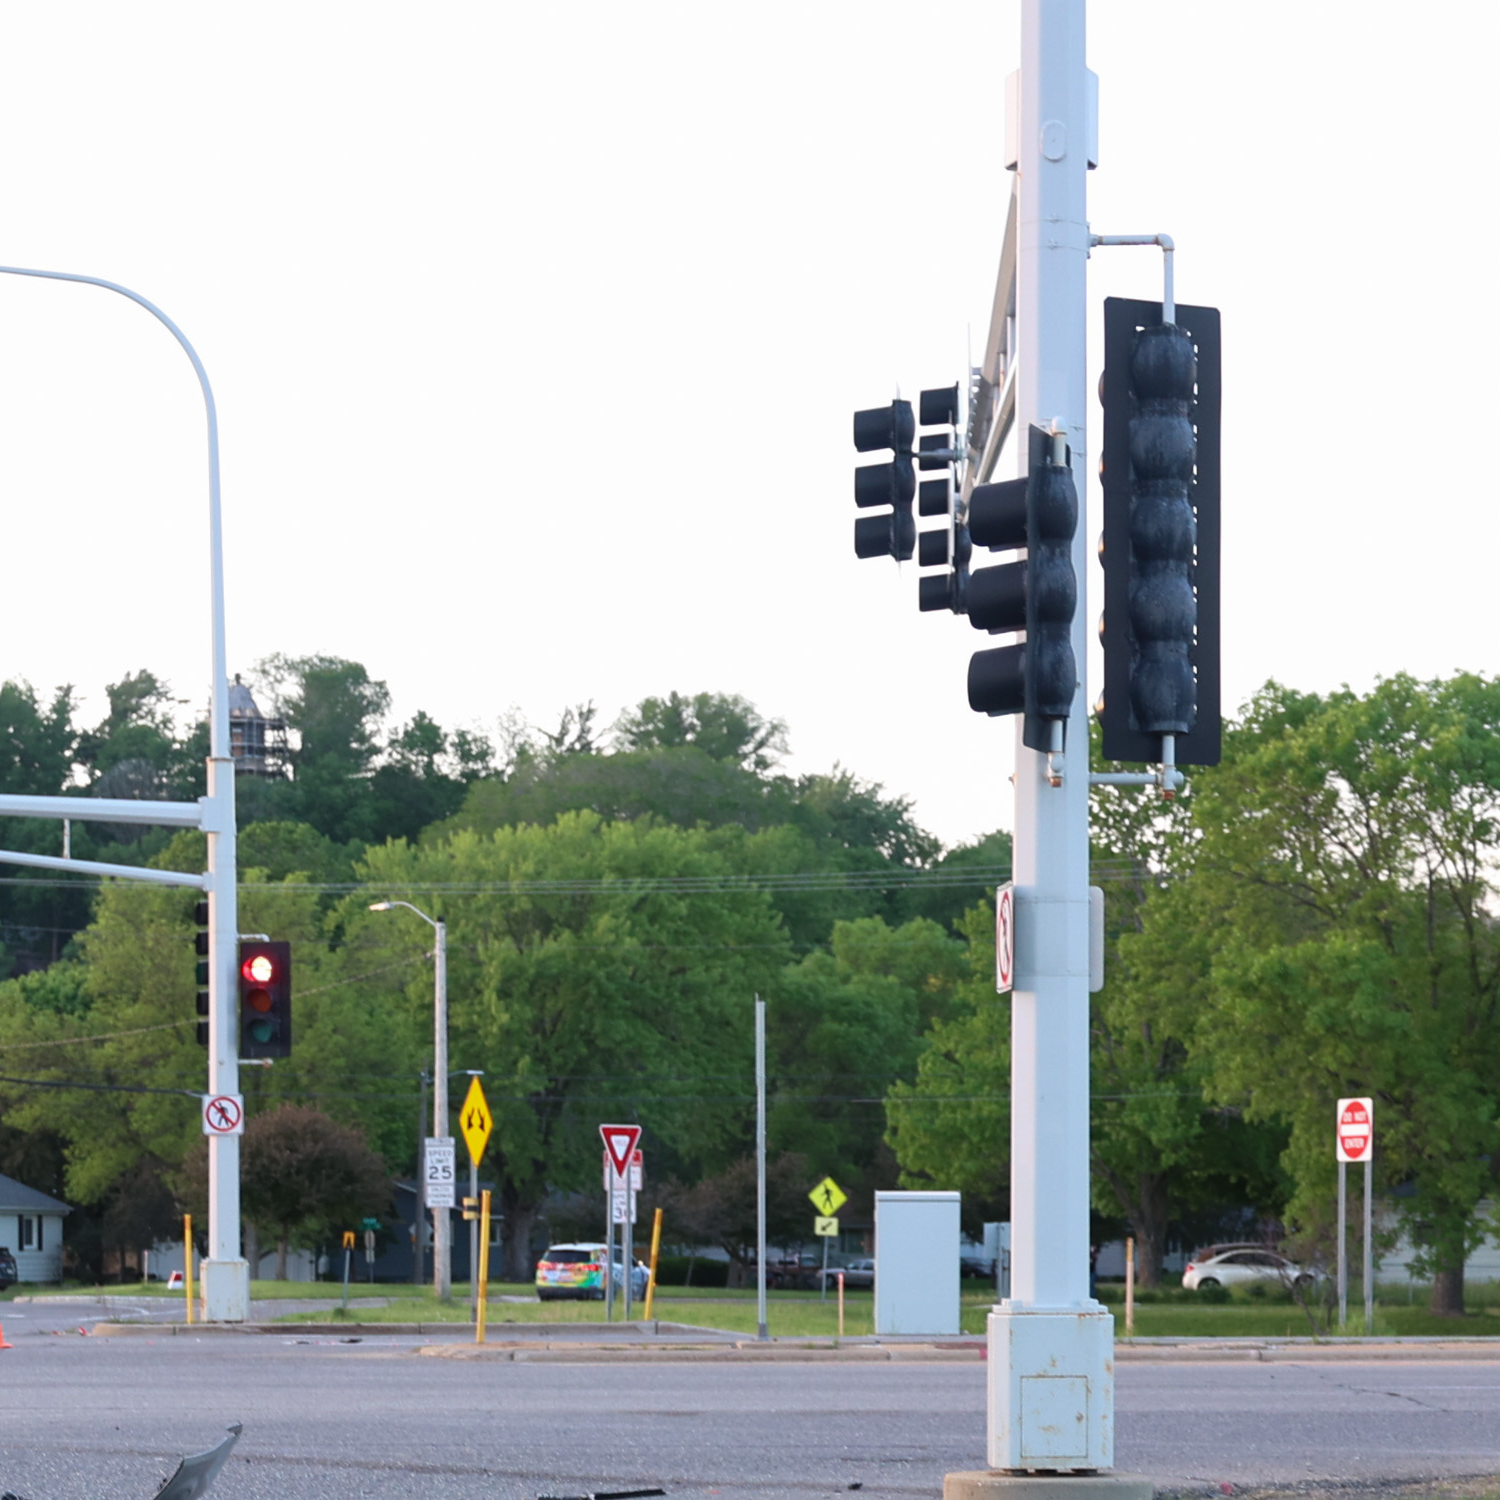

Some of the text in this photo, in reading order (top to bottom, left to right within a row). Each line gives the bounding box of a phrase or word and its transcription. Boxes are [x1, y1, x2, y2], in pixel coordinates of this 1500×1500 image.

[1343, 1111, 1366, 1122] DO NOT
[1344, 1138, 1364, 1149] ENTER
[429, 1166, 452, 1180] 25
